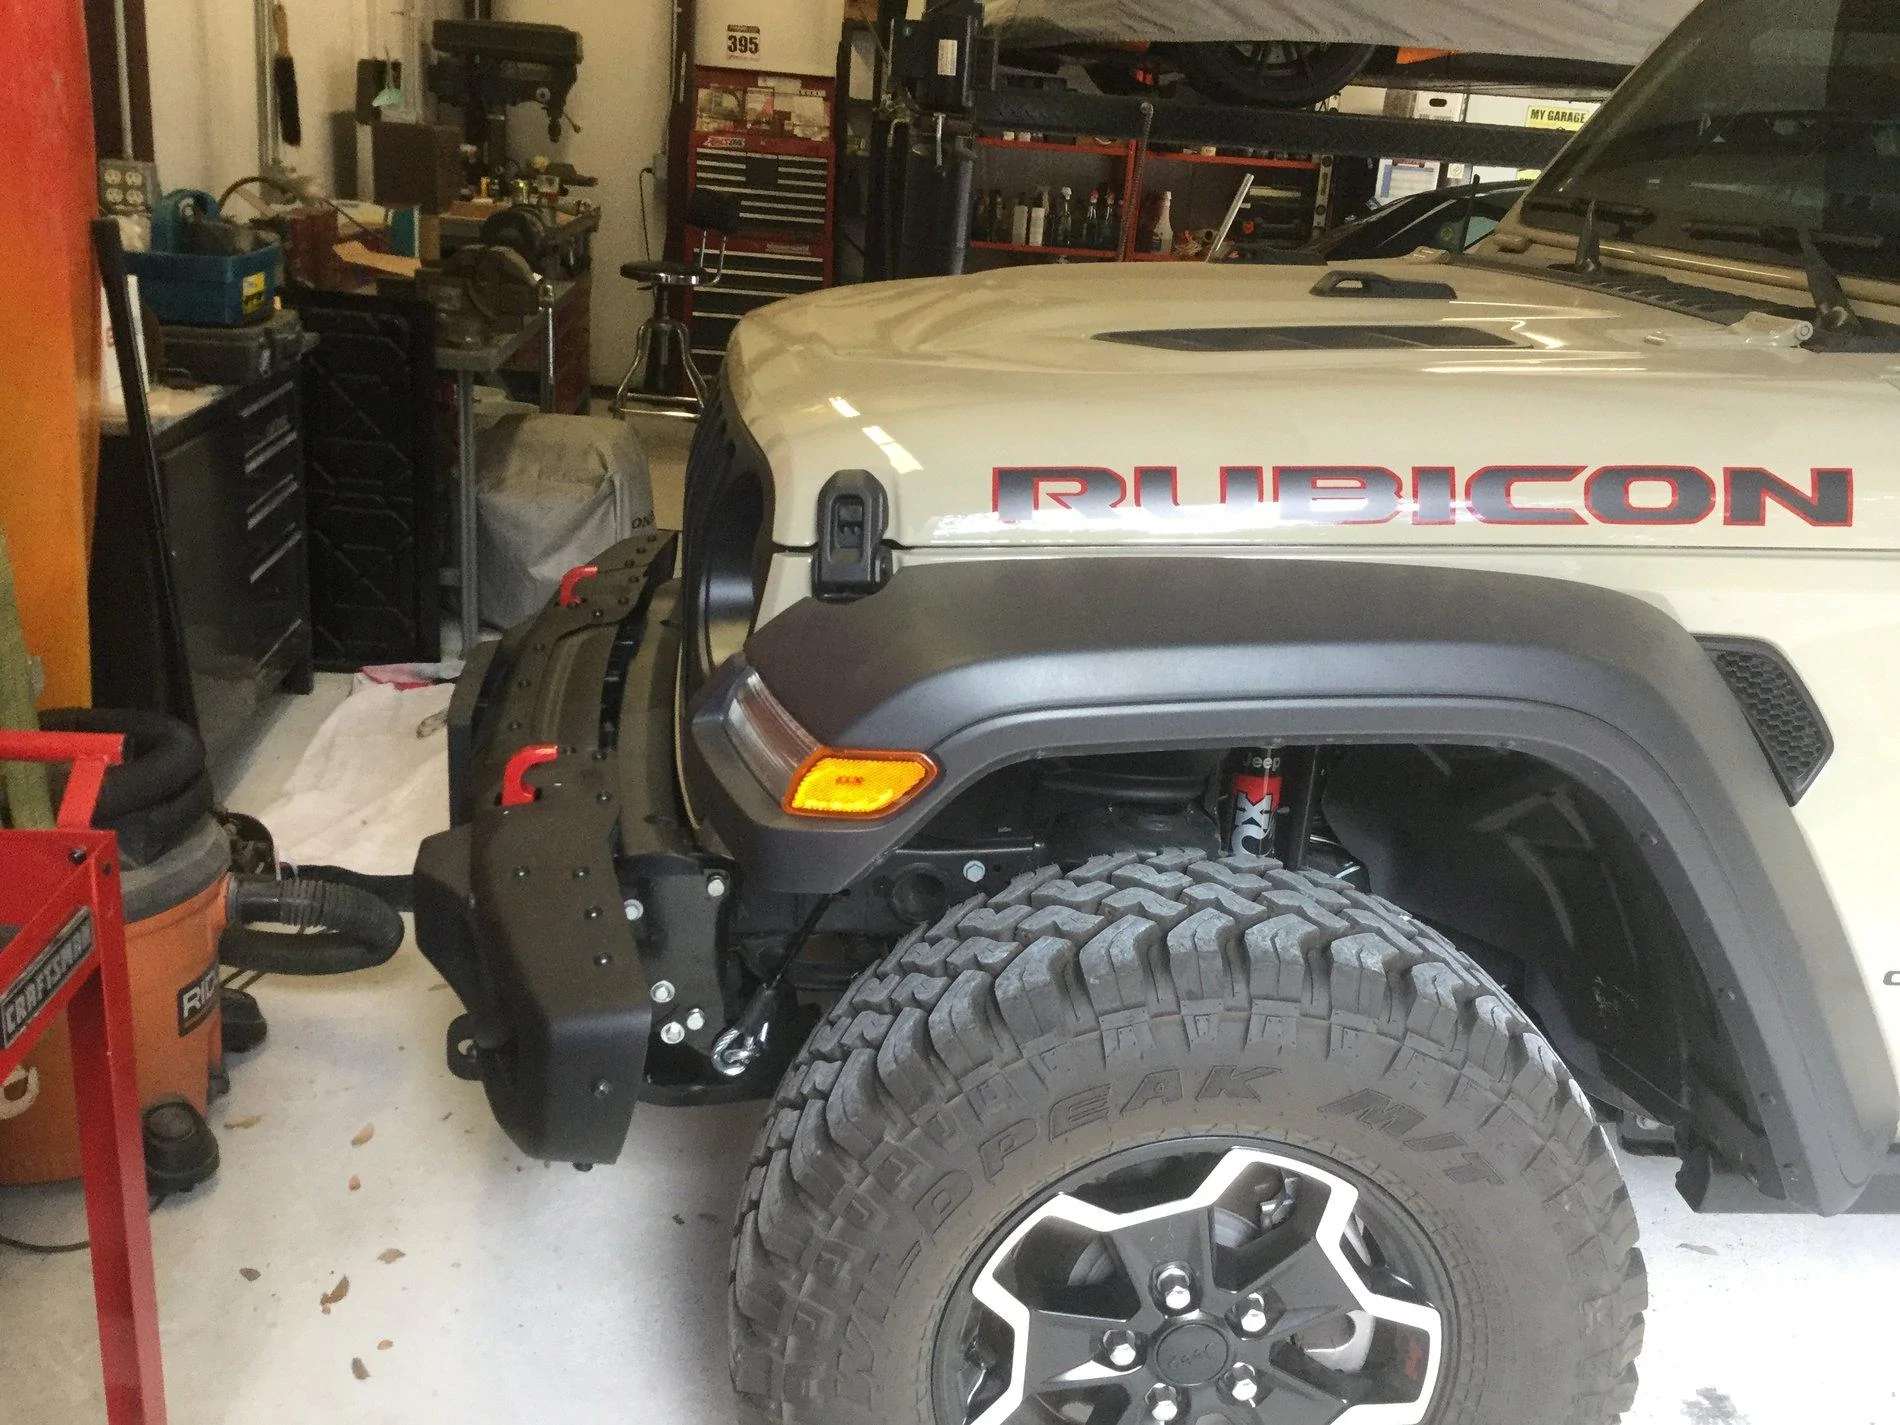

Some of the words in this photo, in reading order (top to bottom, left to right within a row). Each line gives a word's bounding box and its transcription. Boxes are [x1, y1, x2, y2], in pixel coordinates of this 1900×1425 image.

[727, 34, 759, 54] 395
[1530, 108, 1546, 121] MY
[1547, 110, 1587, 124] GARAGE
[992, 464, 1854, 528] RUBICON
[1242, 753, 1281, 772] Jeep
